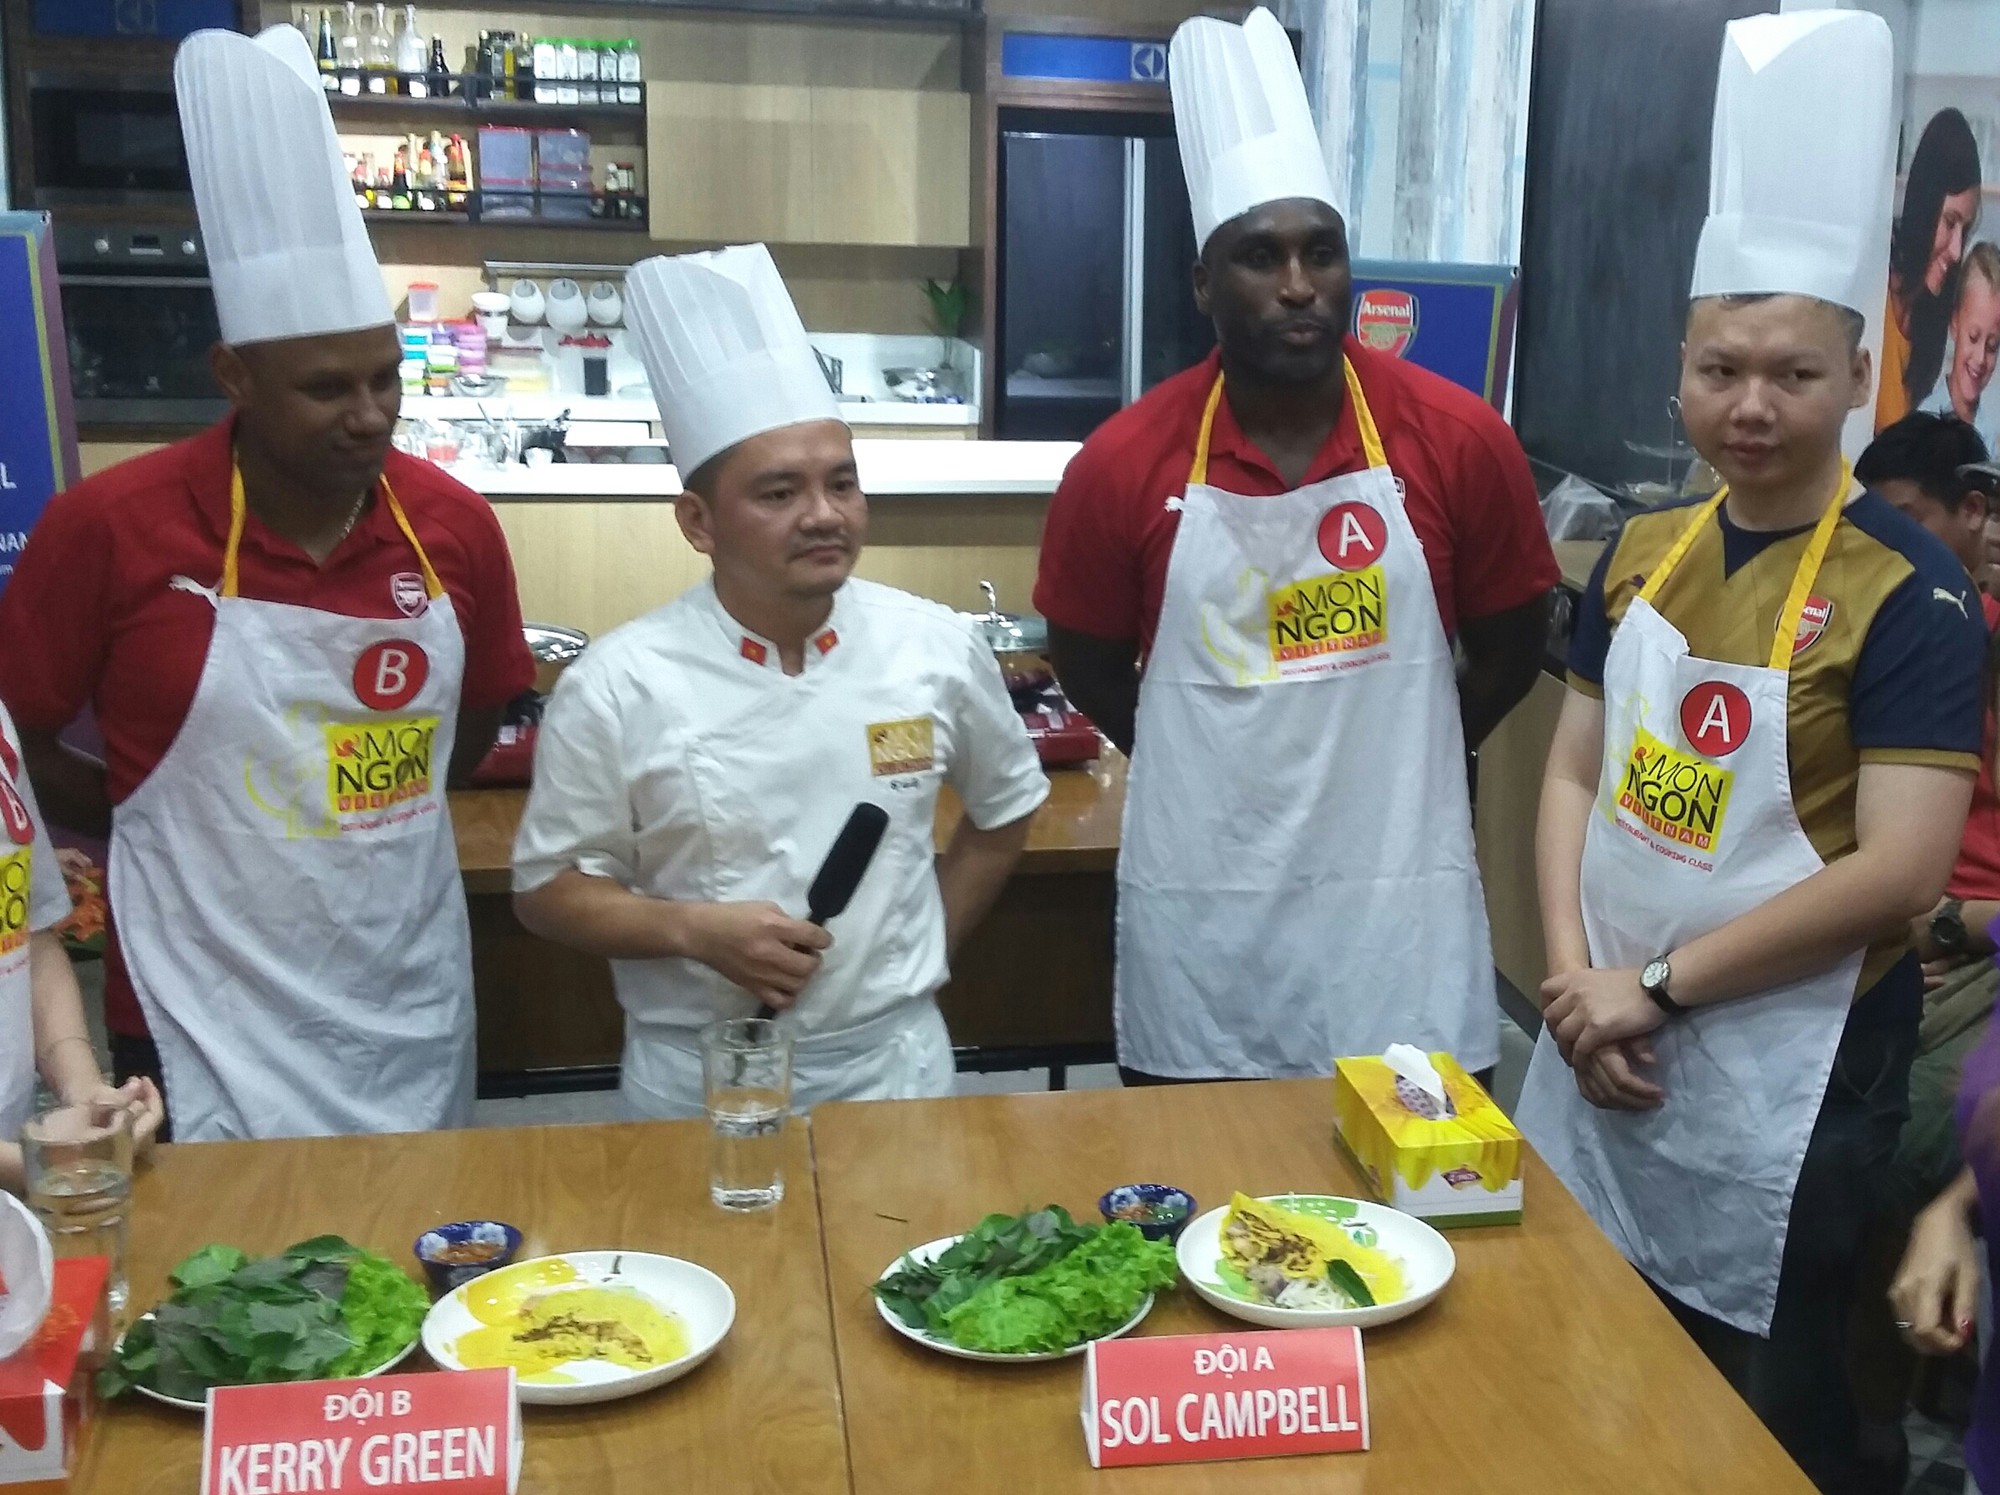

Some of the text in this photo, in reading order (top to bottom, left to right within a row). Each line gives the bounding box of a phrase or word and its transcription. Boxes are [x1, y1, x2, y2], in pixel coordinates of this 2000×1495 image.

[1362, 301, 1411, 318] Arsenal
[0, 462, 17, 489] L
[1337, 511, 1375, 558] A
[1294, 573, 1381, 614] MÓN
[1803, 605, 1827, 618] enal
[1276, 602, 1383, 645] NGON
[374, 648, 410, 696] B
[1696, 694, 1731, 743] A
[1627, 763, 1718, 834] NGON
[1648, 753, 1724, 804] MÓN
[1688, 857, 1713, 873] CLASS
[1193, 1343, 1275, 1379] ĐỘI A
[322, 1387, 412, 1426] ĐỘI B
[1102, 1384, 1359, 1448] SOL CAMPBELL
[217, 1424, 496, 1495] KERRY GREEN
